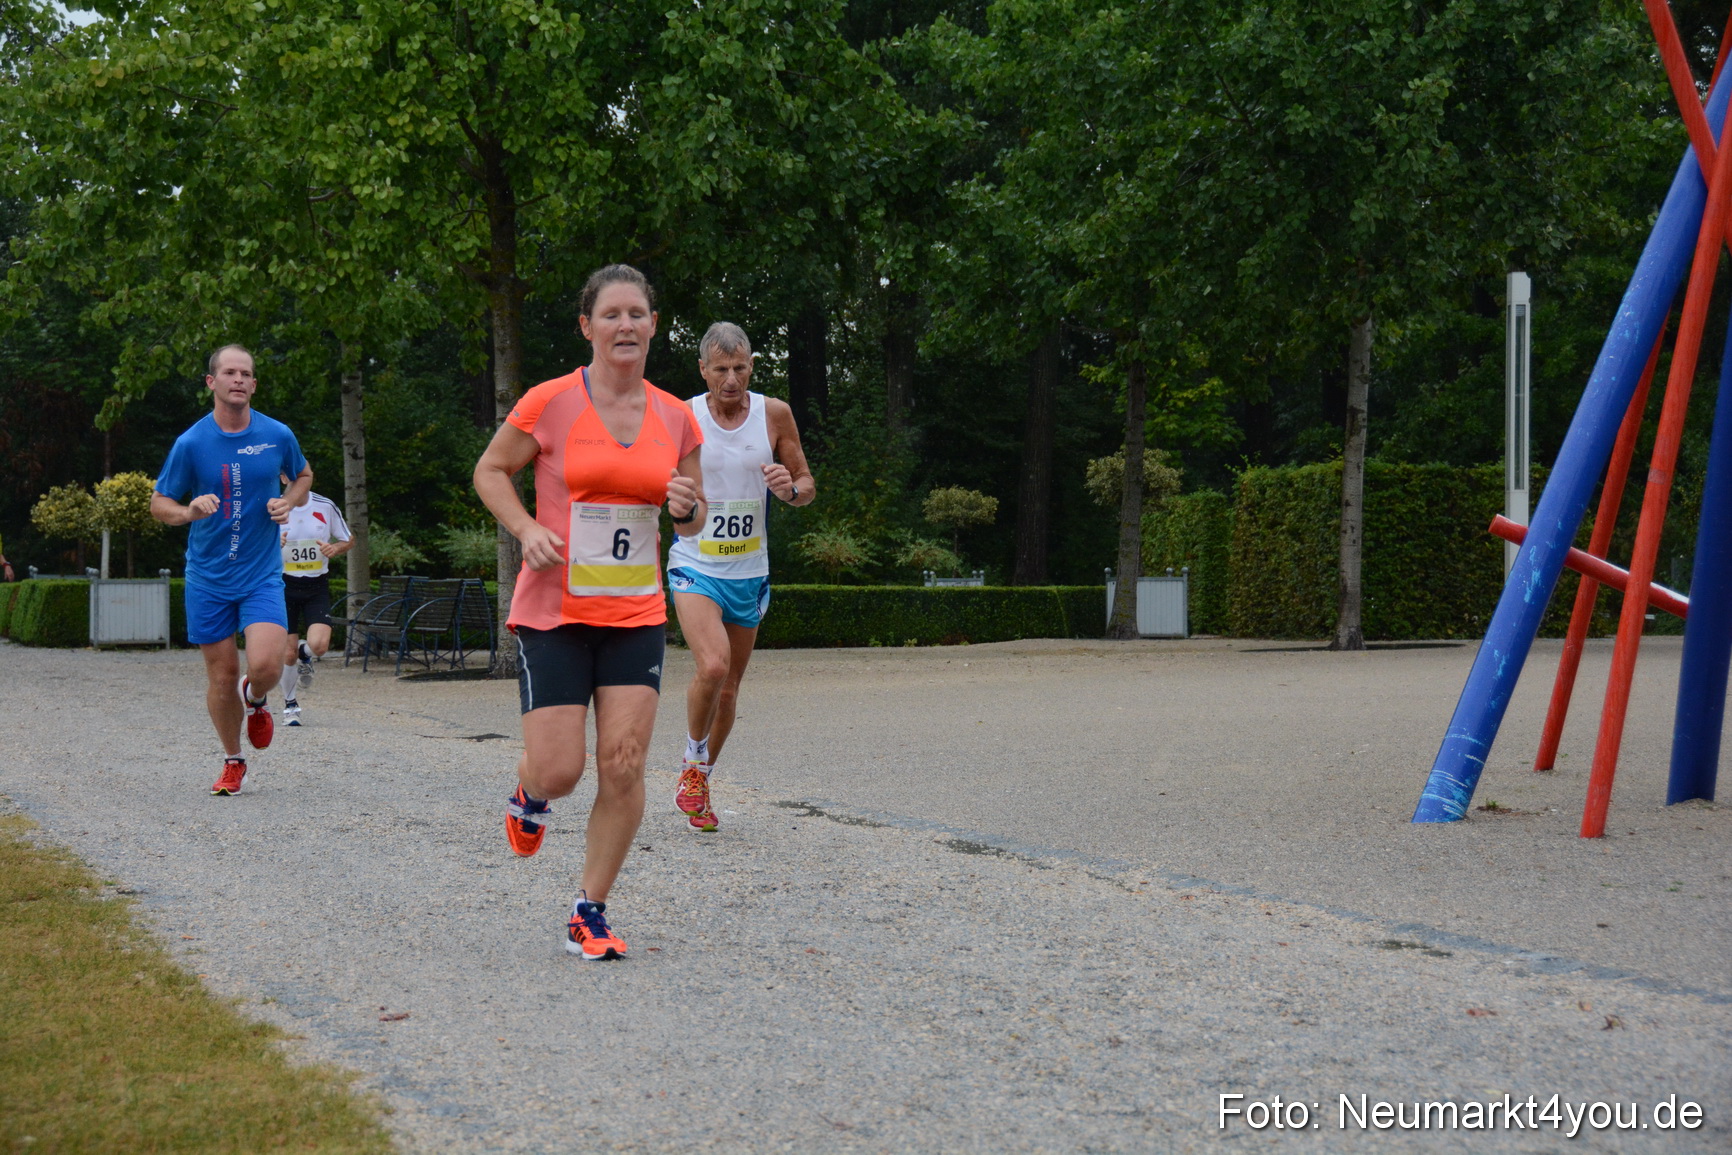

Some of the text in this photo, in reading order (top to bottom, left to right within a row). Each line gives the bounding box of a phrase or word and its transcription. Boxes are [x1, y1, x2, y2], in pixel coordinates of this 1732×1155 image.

[221, 464, 231, 499] FINISHER
[231, 463, 242, 485] SWIM
[233, 501, 242, 519] BIKE
[617, 508, 654, 520] BOCK
[729, 501, 760, 511] BOCK
[713, 514, 754, 538] 268
[230, 535, 240, 552] RUN
[612, 528, 631, 561] 6
[718, 544, 746, 555] Egbert
[291, 547, 317, 562] 346
